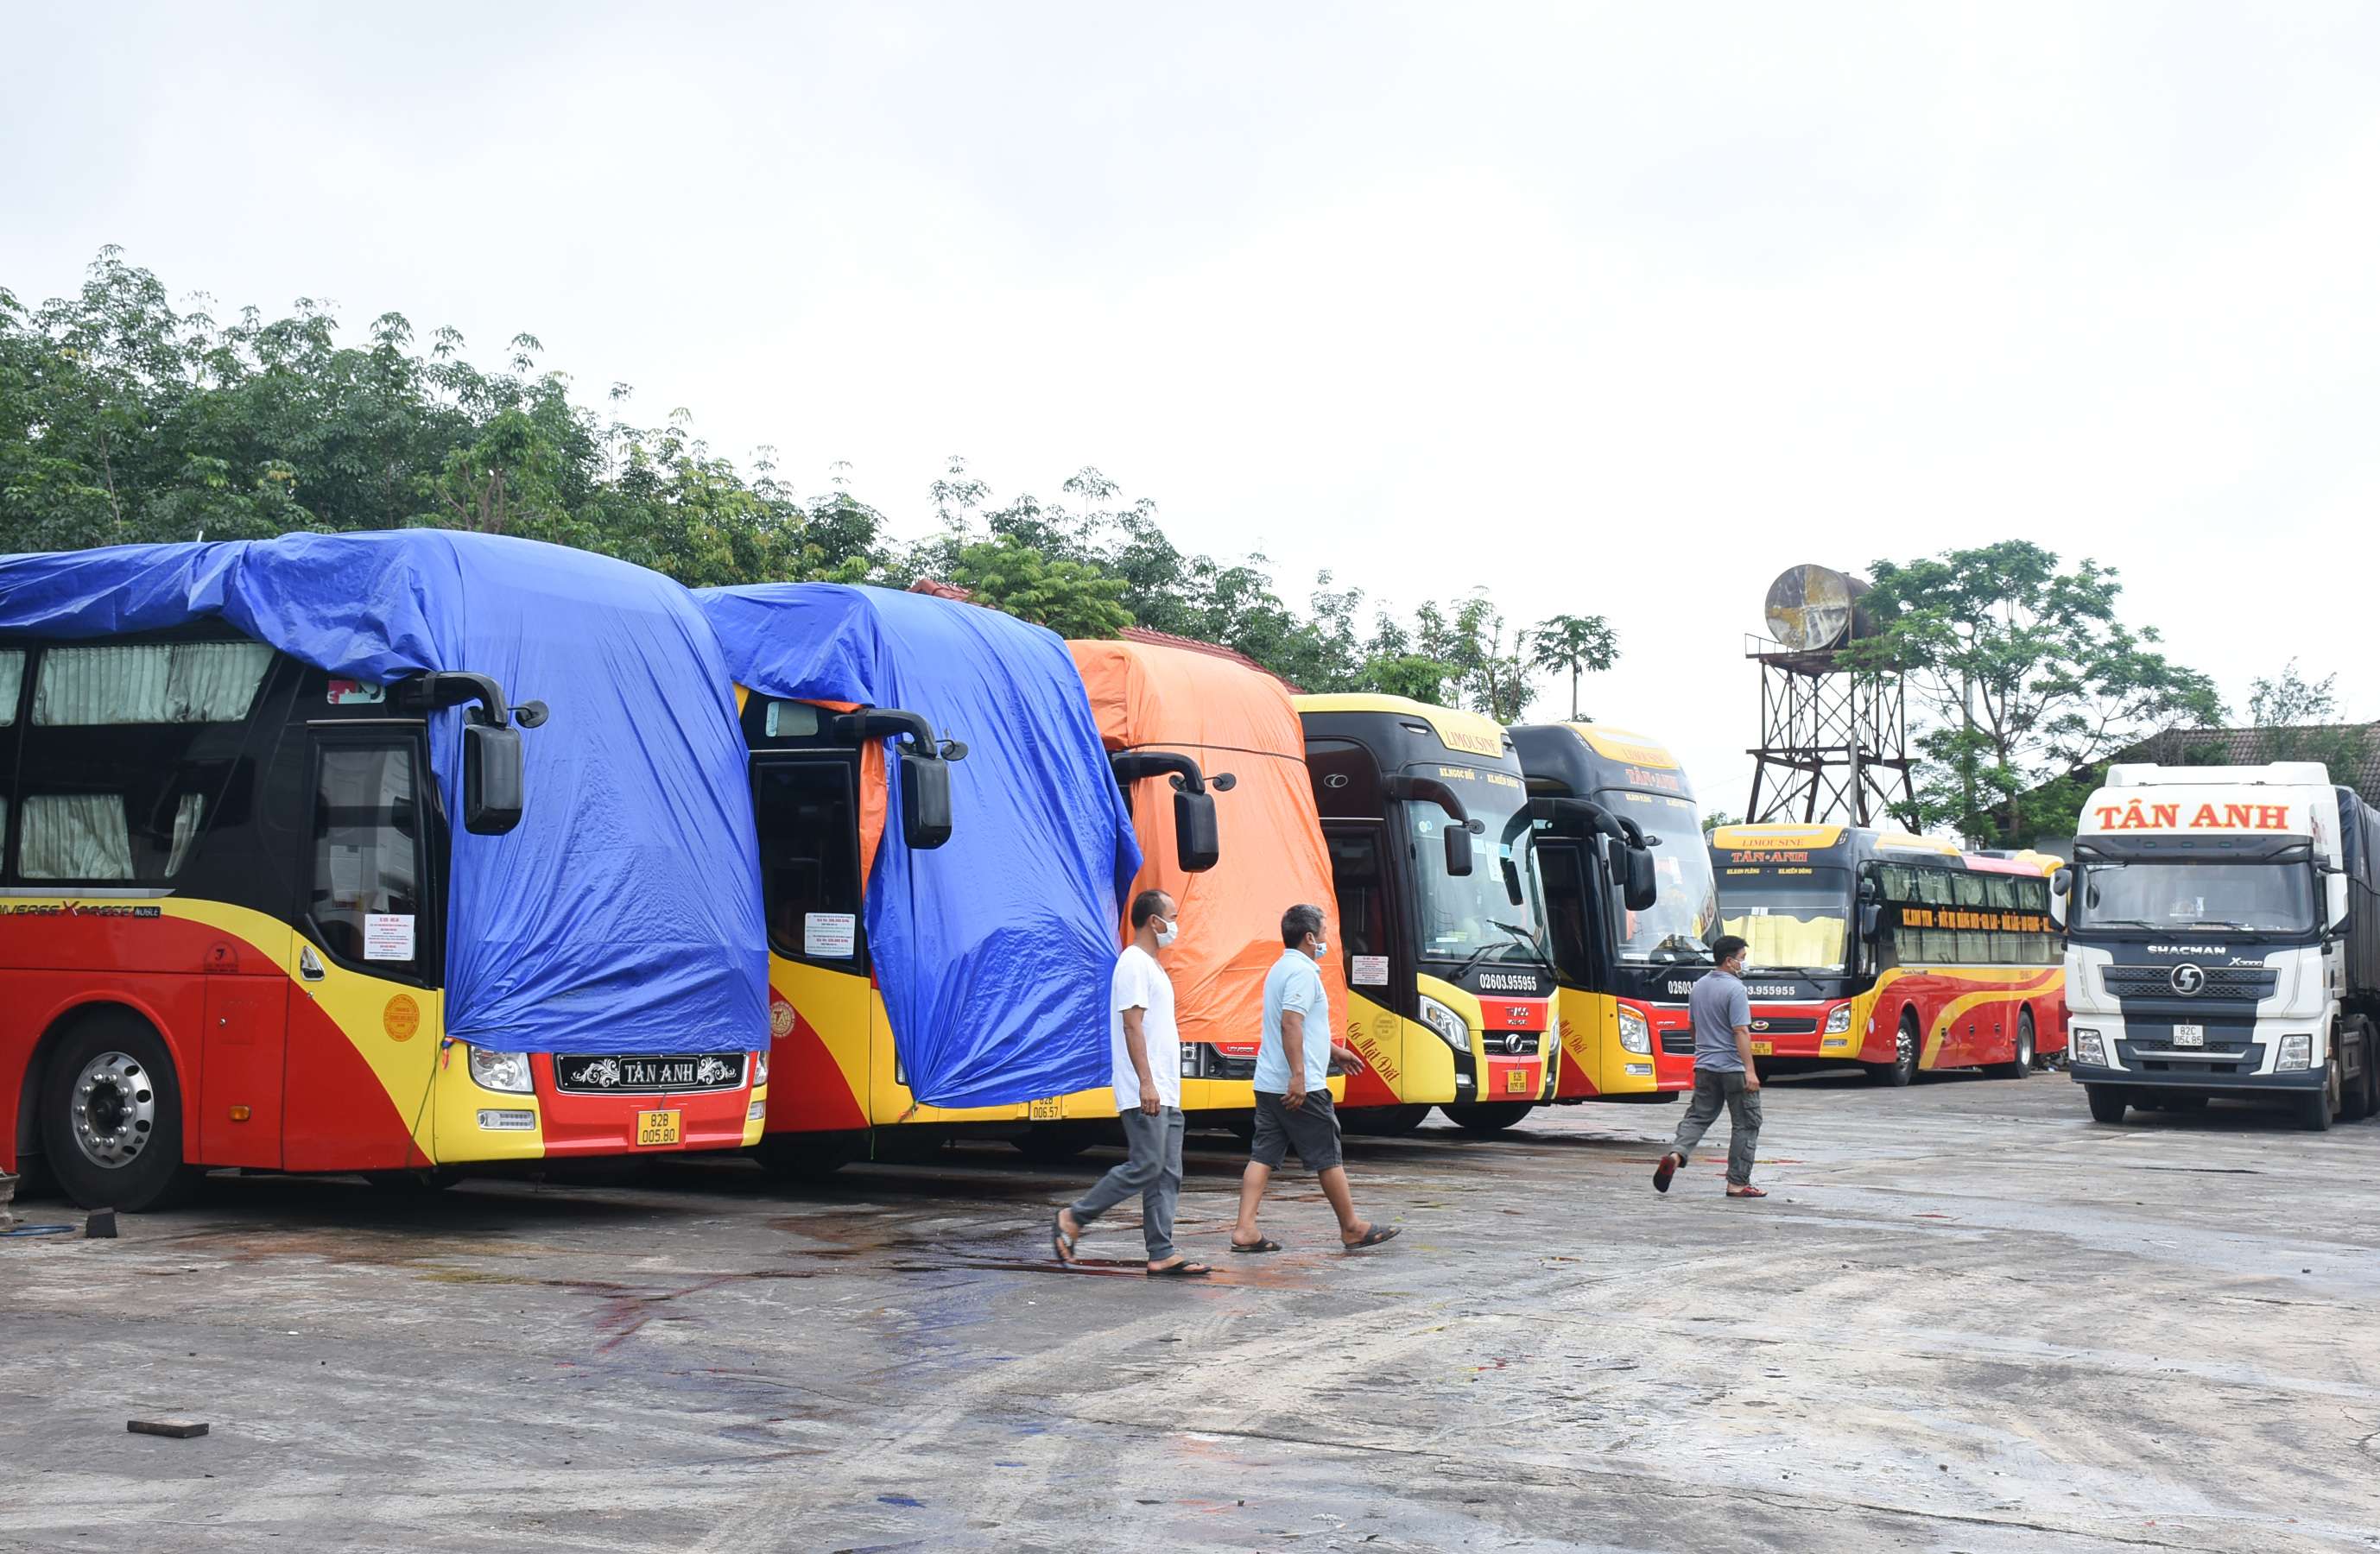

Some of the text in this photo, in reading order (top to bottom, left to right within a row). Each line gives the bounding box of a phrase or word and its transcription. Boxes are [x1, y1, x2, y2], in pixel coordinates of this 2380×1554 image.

[1445, 730, 1499, 755] LIMOUSINE
[2094, 798, 2290, 831] TÂN ANH
[1742, 838, 1804, 847] LIMOUSINE
[2147, 945, 2226, 955] SHACMAN
[1479, 973, 1537, 992] 02603.955955
[2180, 1027, 2197, 1036] 82C
[624, 1061, 694, 1083] TÂN ANH
[1033, 1106, 1059, 1119] 006.57
[650, 1113, 669, 1127] 82B
[642, 1128, 675, 1143] 005.80
